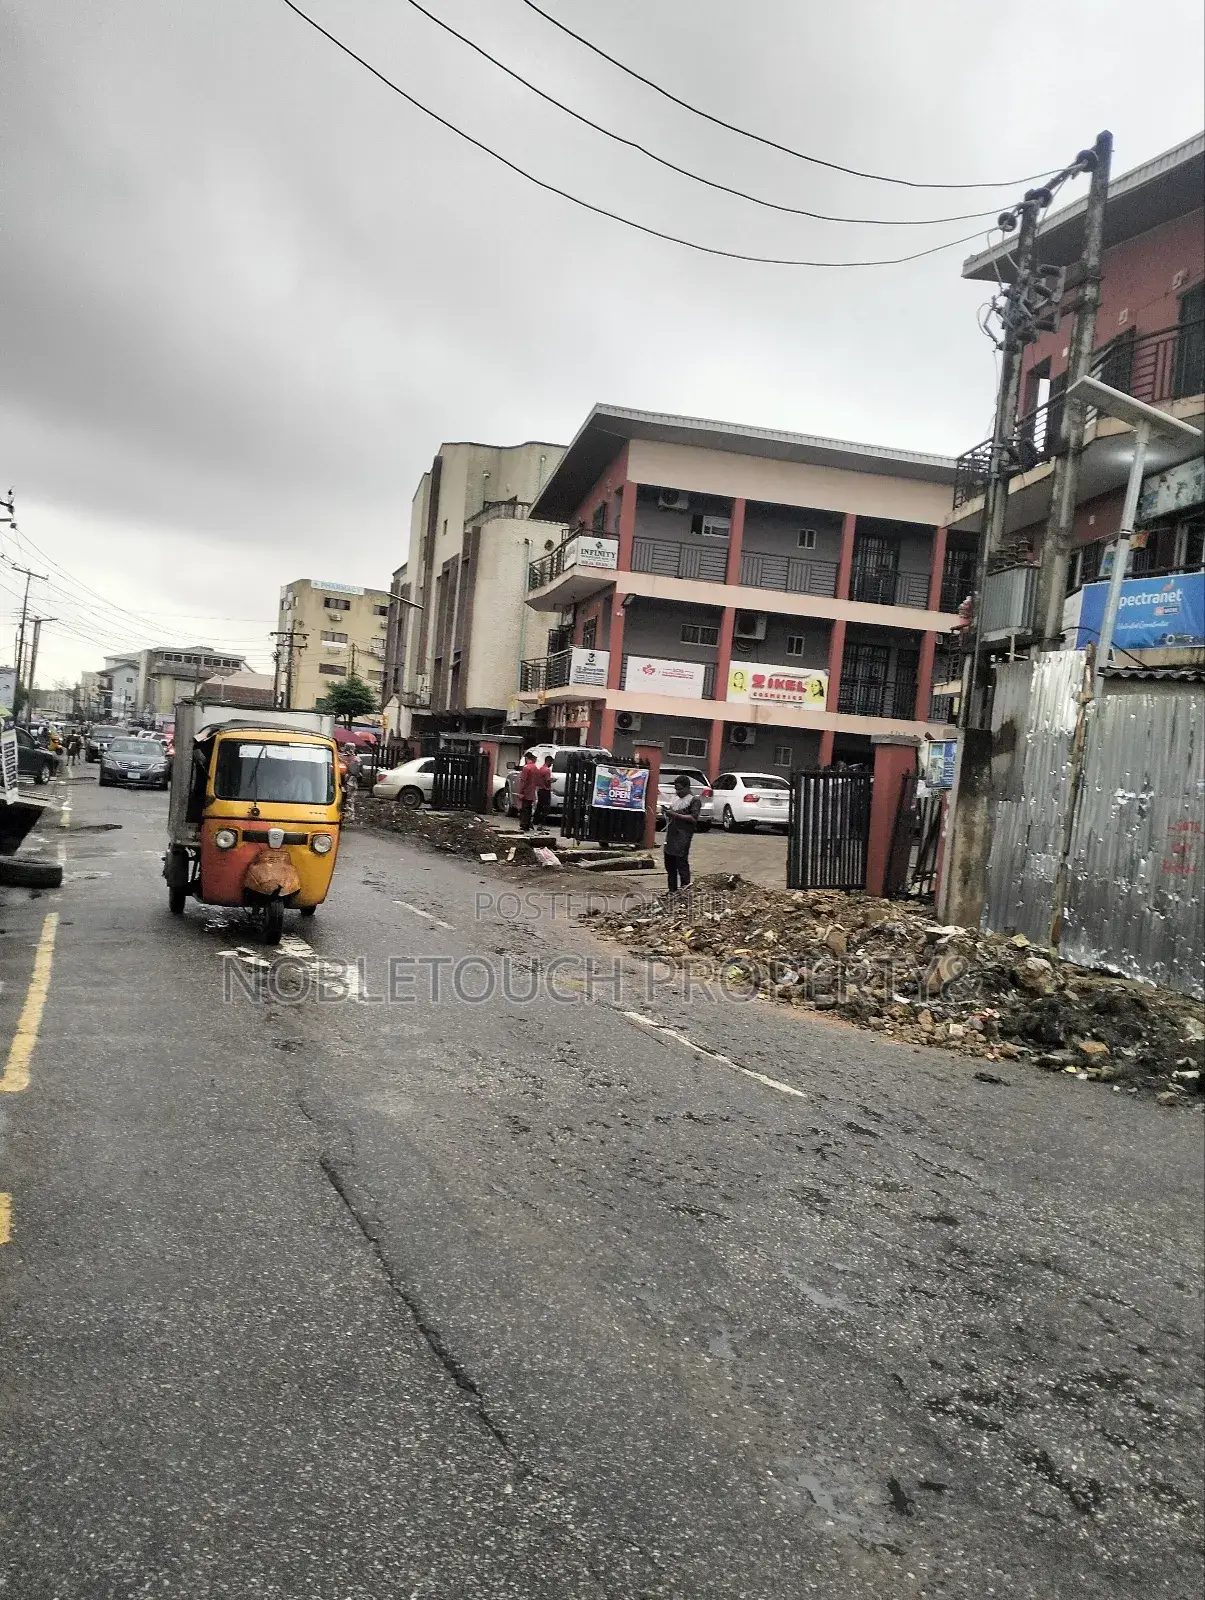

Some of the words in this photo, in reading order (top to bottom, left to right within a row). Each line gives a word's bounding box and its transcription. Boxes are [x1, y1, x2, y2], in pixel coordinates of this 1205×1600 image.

[580, 548, 617, 559] INFINITY
[1118, 588, 1183, 610] pectranet
[751, 673, 808, 693] ZIKEL
[752, 692, 804, 701] COSMETICS
[608, 789, 632, 799] OPEN
